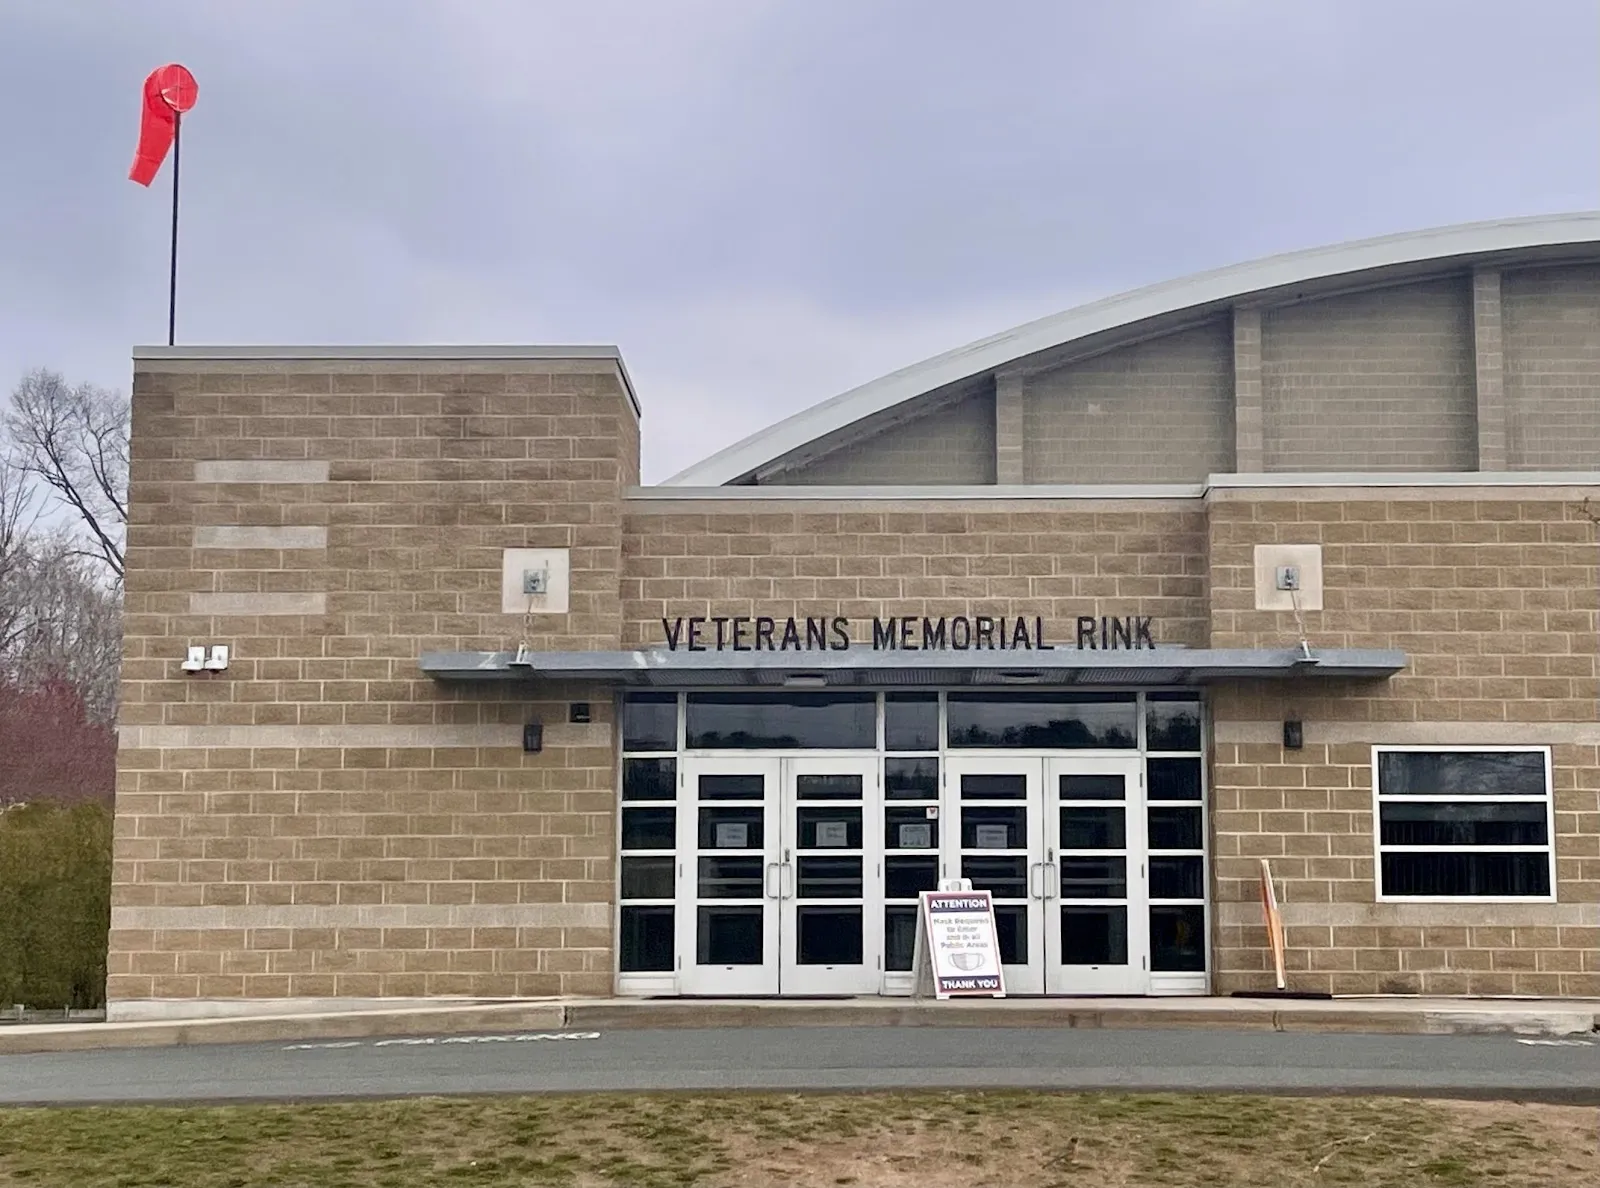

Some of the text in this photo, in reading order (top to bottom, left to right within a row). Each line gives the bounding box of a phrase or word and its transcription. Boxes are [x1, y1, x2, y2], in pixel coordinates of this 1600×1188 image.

[662, 616, 1156, 651] VETERANS MEMORIAL RINK
[931, 899, 987, 909] ATTENTION
[943, 979, 998, 989] THANK YOU
